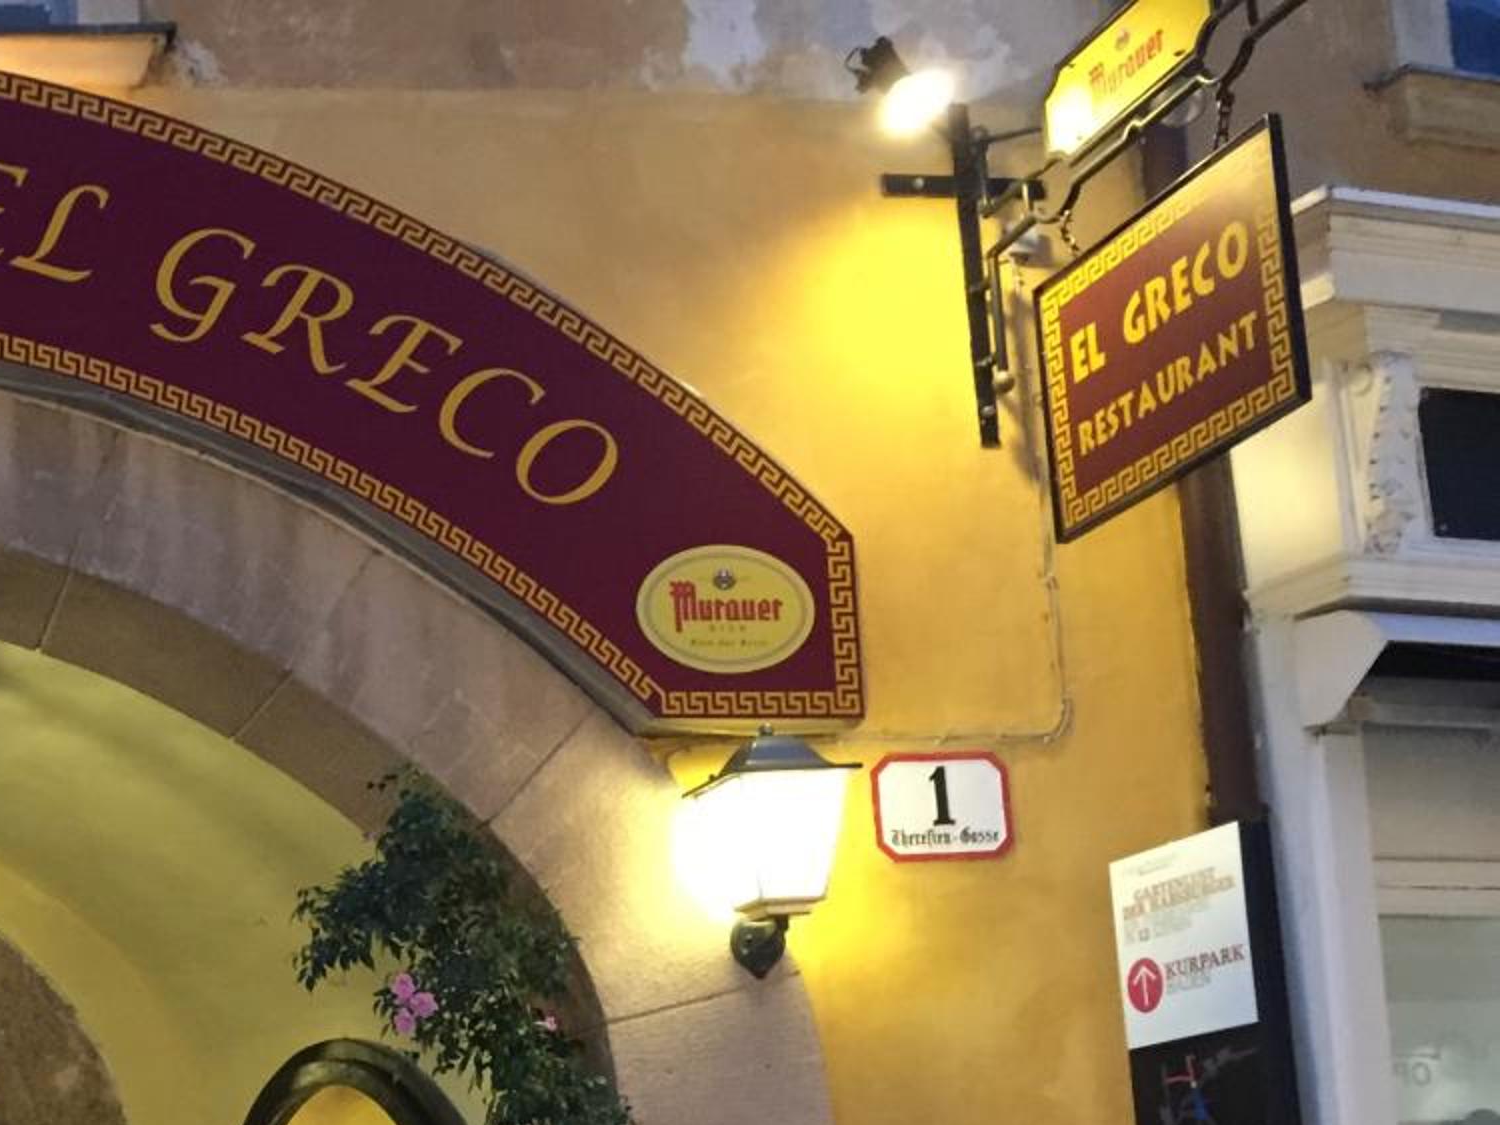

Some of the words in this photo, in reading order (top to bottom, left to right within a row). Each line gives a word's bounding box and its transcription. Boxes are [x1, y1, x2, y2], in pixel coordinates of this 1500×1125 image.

[1069, 326, 1106, 384] EL
[1122, 219, 1249, 347] GRECO
[149, 227, 620, 506] GRECO
[1077, 311, 1258, 457] RESTAURANT
[669, 580, 784, 633] Murauer
[928, 765, 957, 827] 1
[1164, 944, 1246, 979] KURPARK
